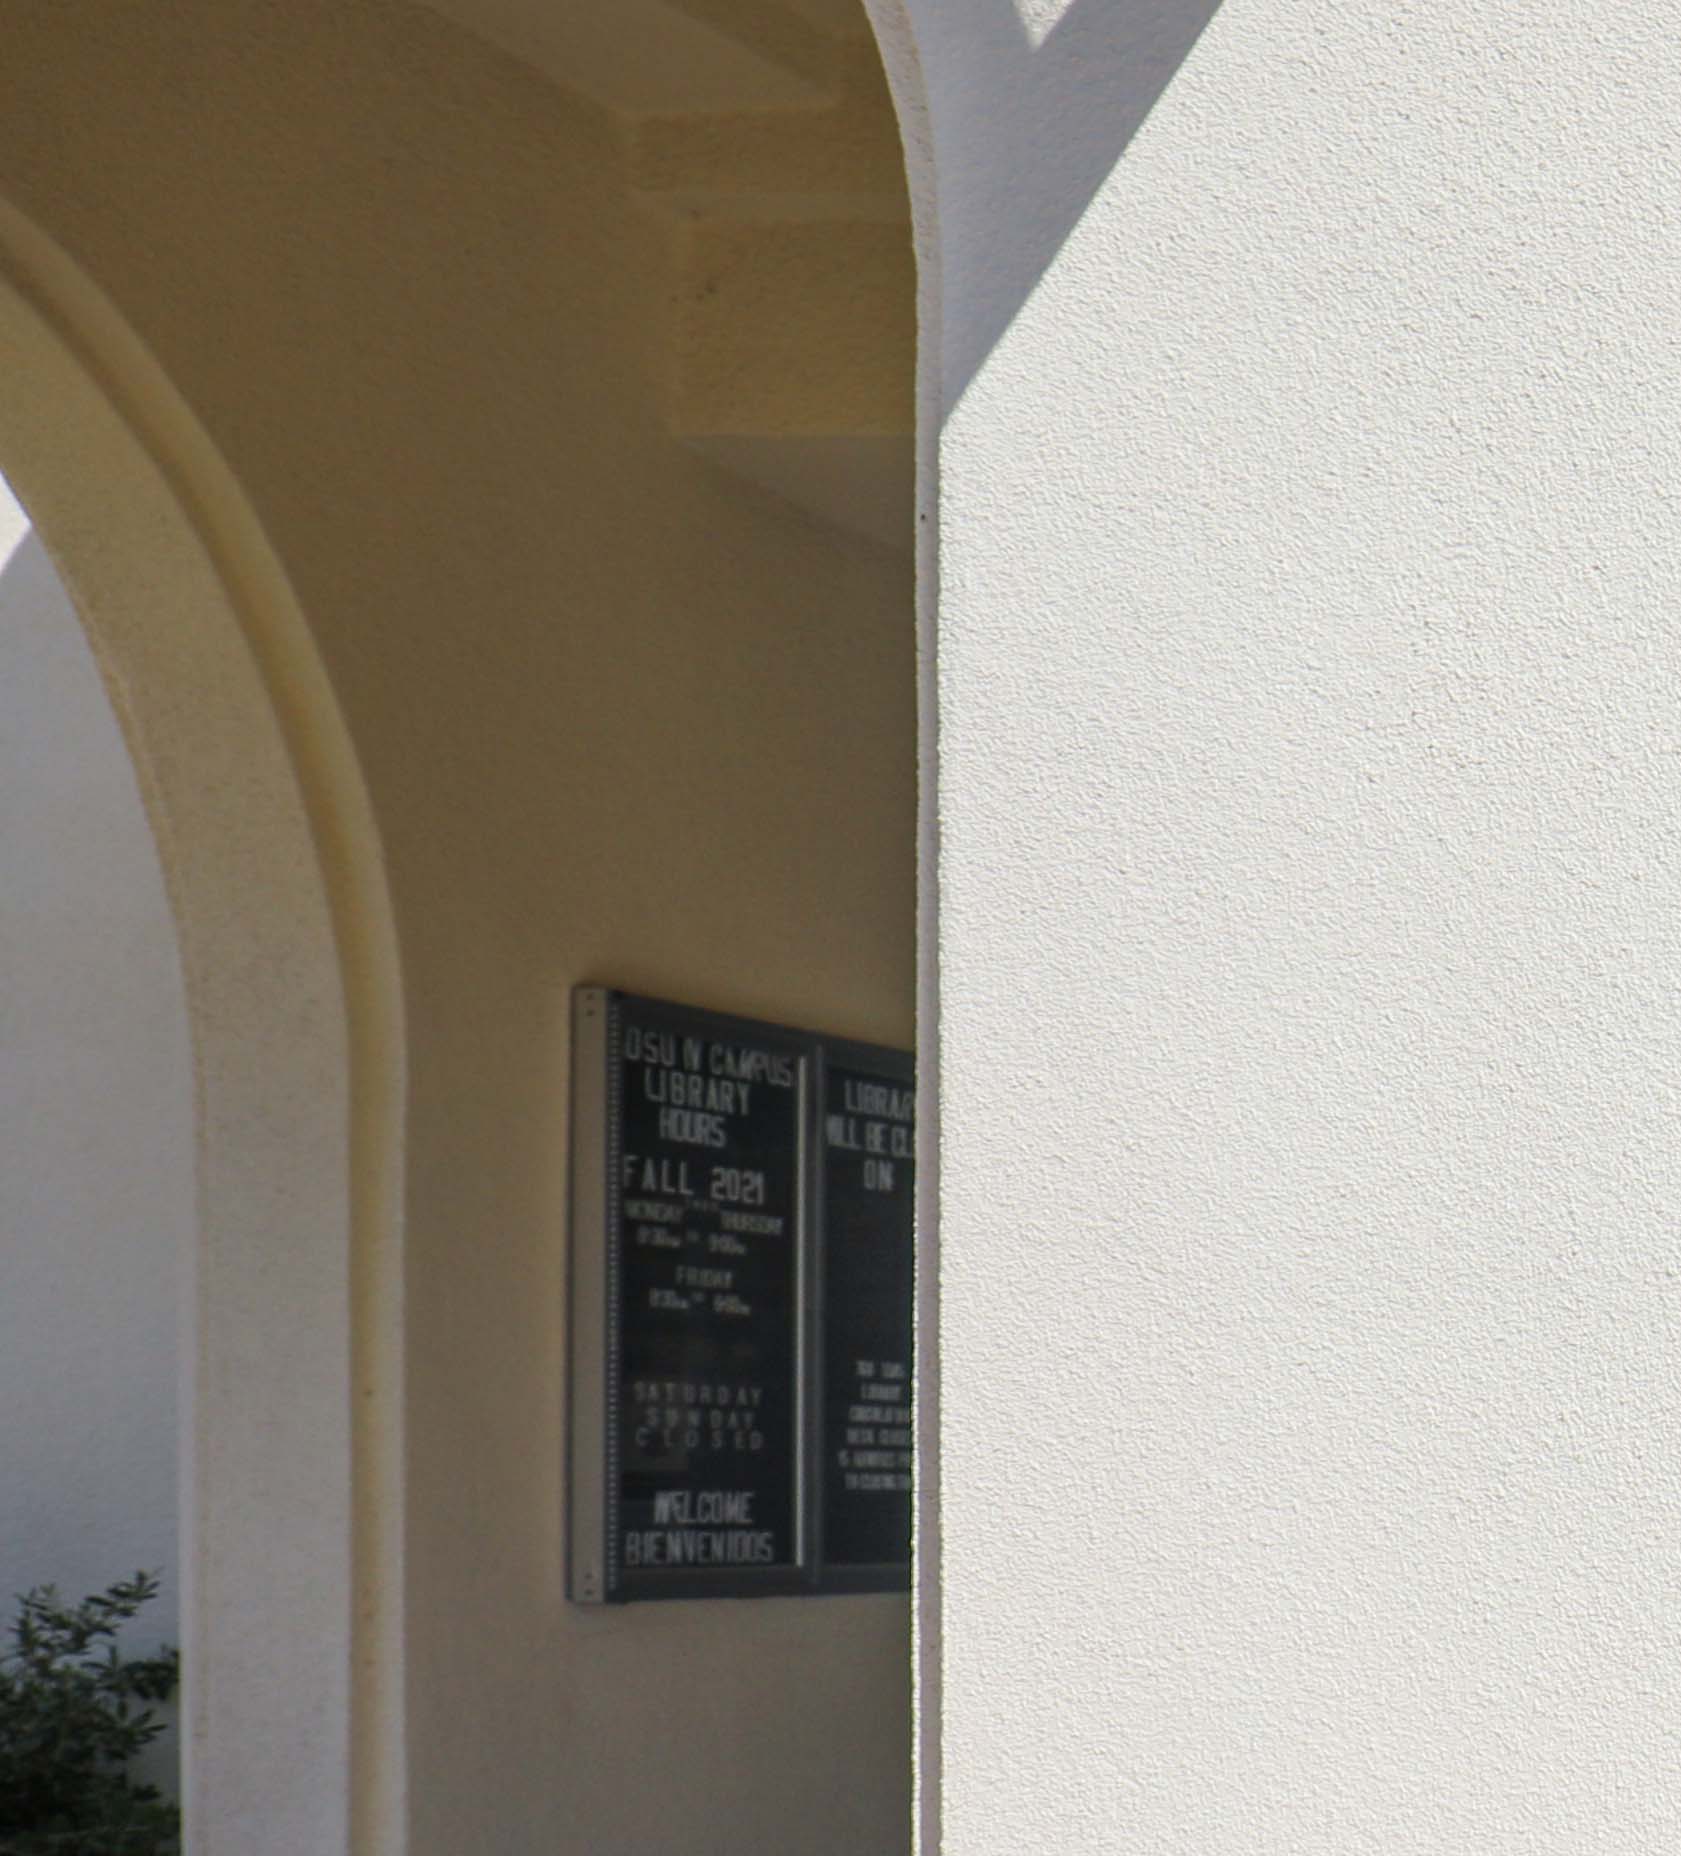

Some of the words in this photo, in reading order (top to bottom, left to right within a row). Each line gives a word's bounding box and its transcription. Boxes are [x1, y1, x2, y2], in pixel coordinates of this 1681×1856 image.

[709, 1043, 792, 1088] CAMPUS
[644, 1067, 749, 1116] LIBRARY
[658, 1105, 727, 1148] HOURS
[865, 1121, 887, 1153] BE
[623, 1154, 694, 1196] FALL
[710, 1166, 765, 1206] 2021
[864, 1159, 894, 1191] ON
[675, 1265, 734, 1289] FRIDAY
[633, 1380, 763, 1406] SATURDAY
[645, 1407, 757, 1430] SUNDAY
[635, 1426, 765, 1452] CLOSED
[654, 1489, 755, 1525] WELCOME
[624, 1530, 775, 1568] BIENVENIDOS
